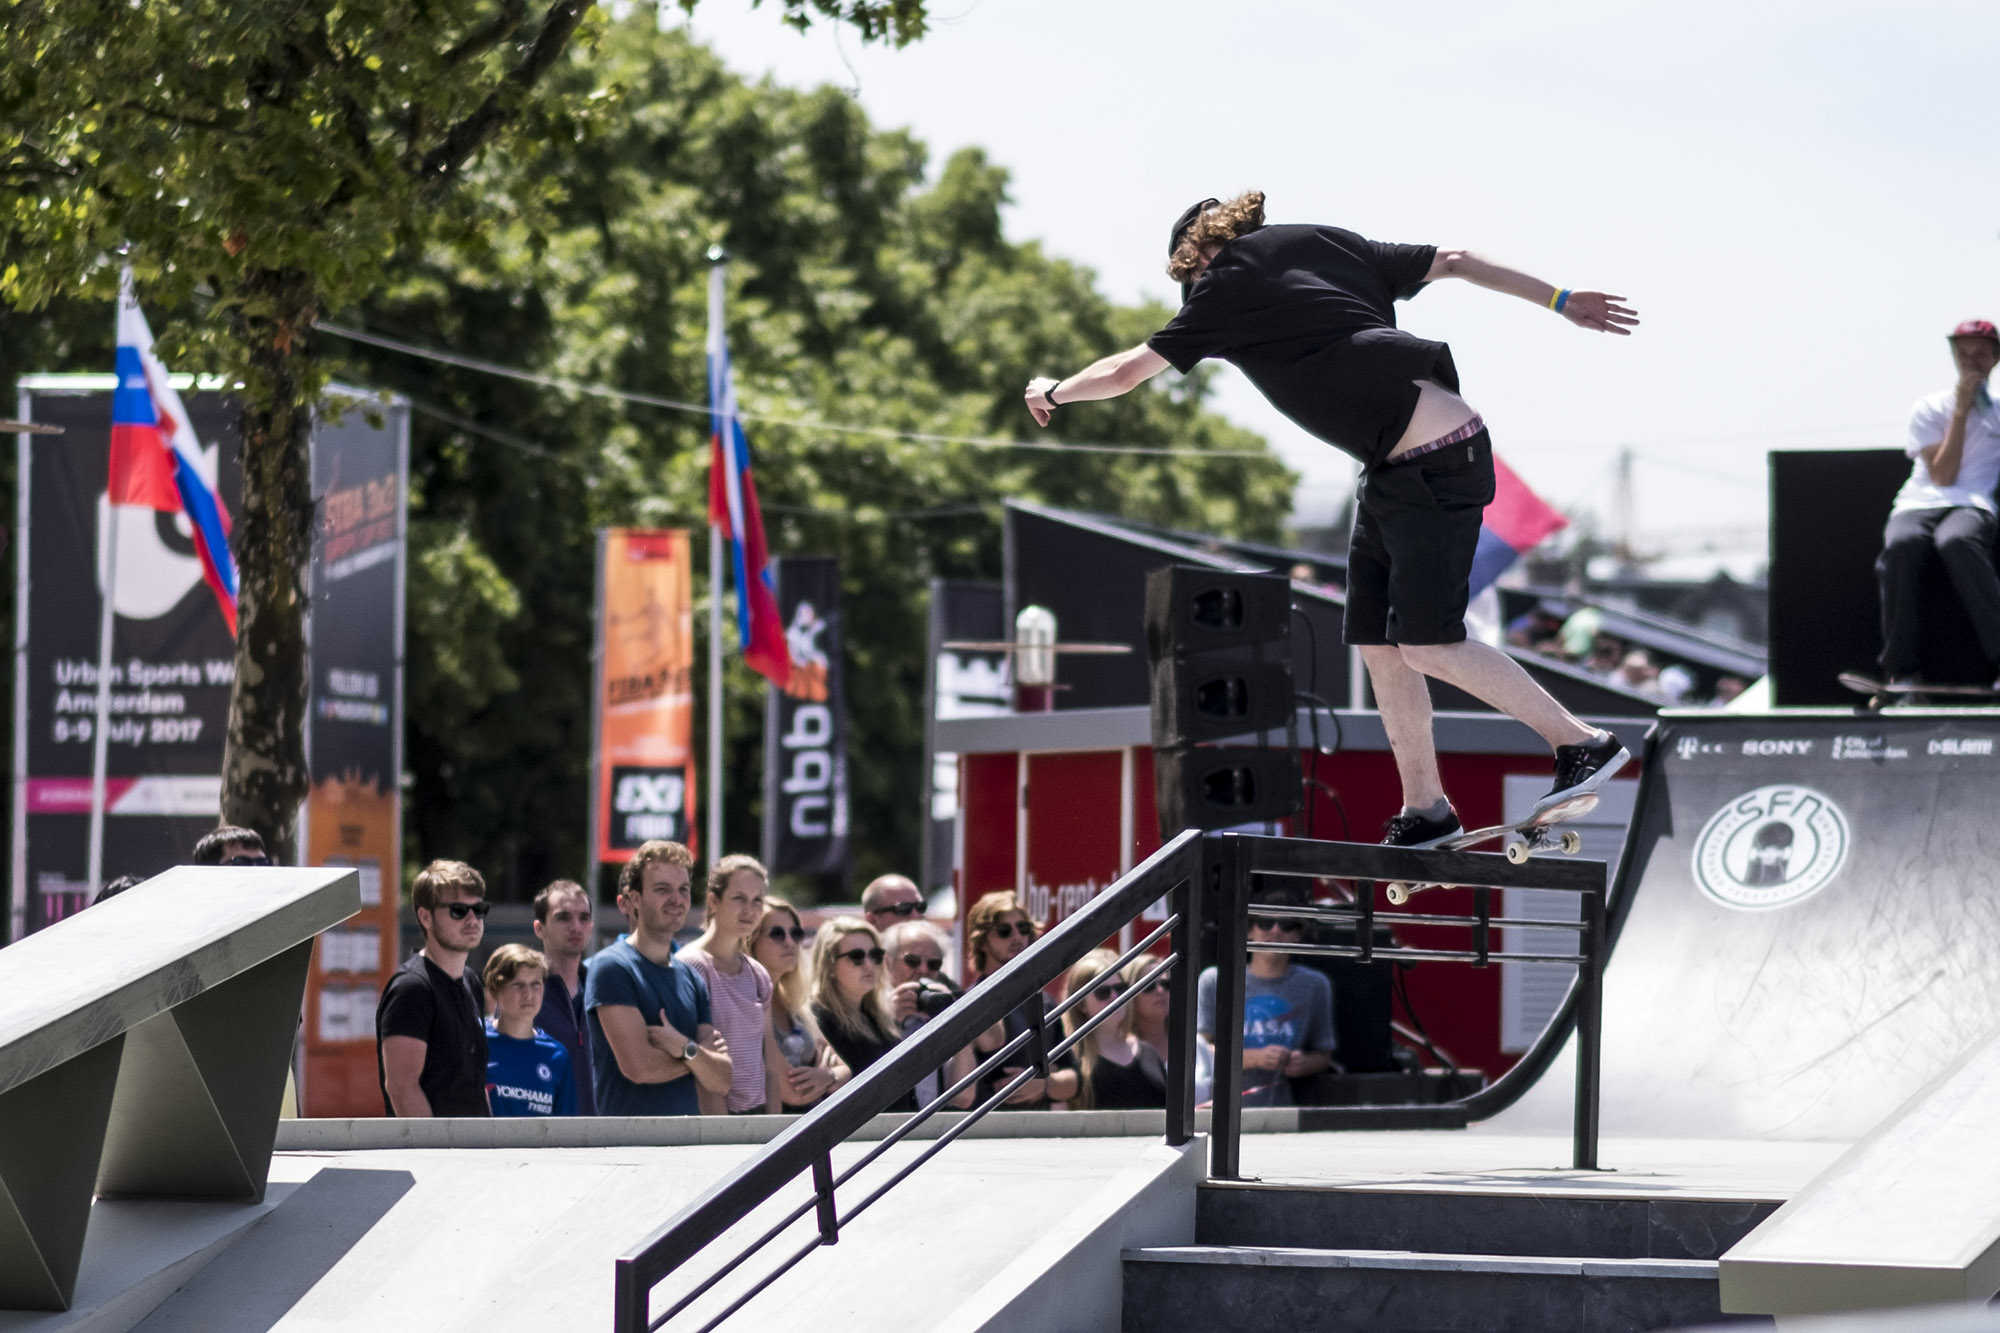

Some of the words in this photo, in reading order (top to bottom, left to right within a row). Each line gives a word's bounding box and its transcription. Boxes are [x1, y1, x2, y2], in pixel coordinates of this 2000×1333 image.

[129, 658, 201, 690] Sports
[205, 659, 235, 684] W
[56, 688, 185, 713] Amerdam
[108, 718, 145, 747] uly
[152, 718, 203, 742] 2017
[1741, 738, 1813, 756] SONY
[496, 1084, 553, 1105] YOKOHAMA
